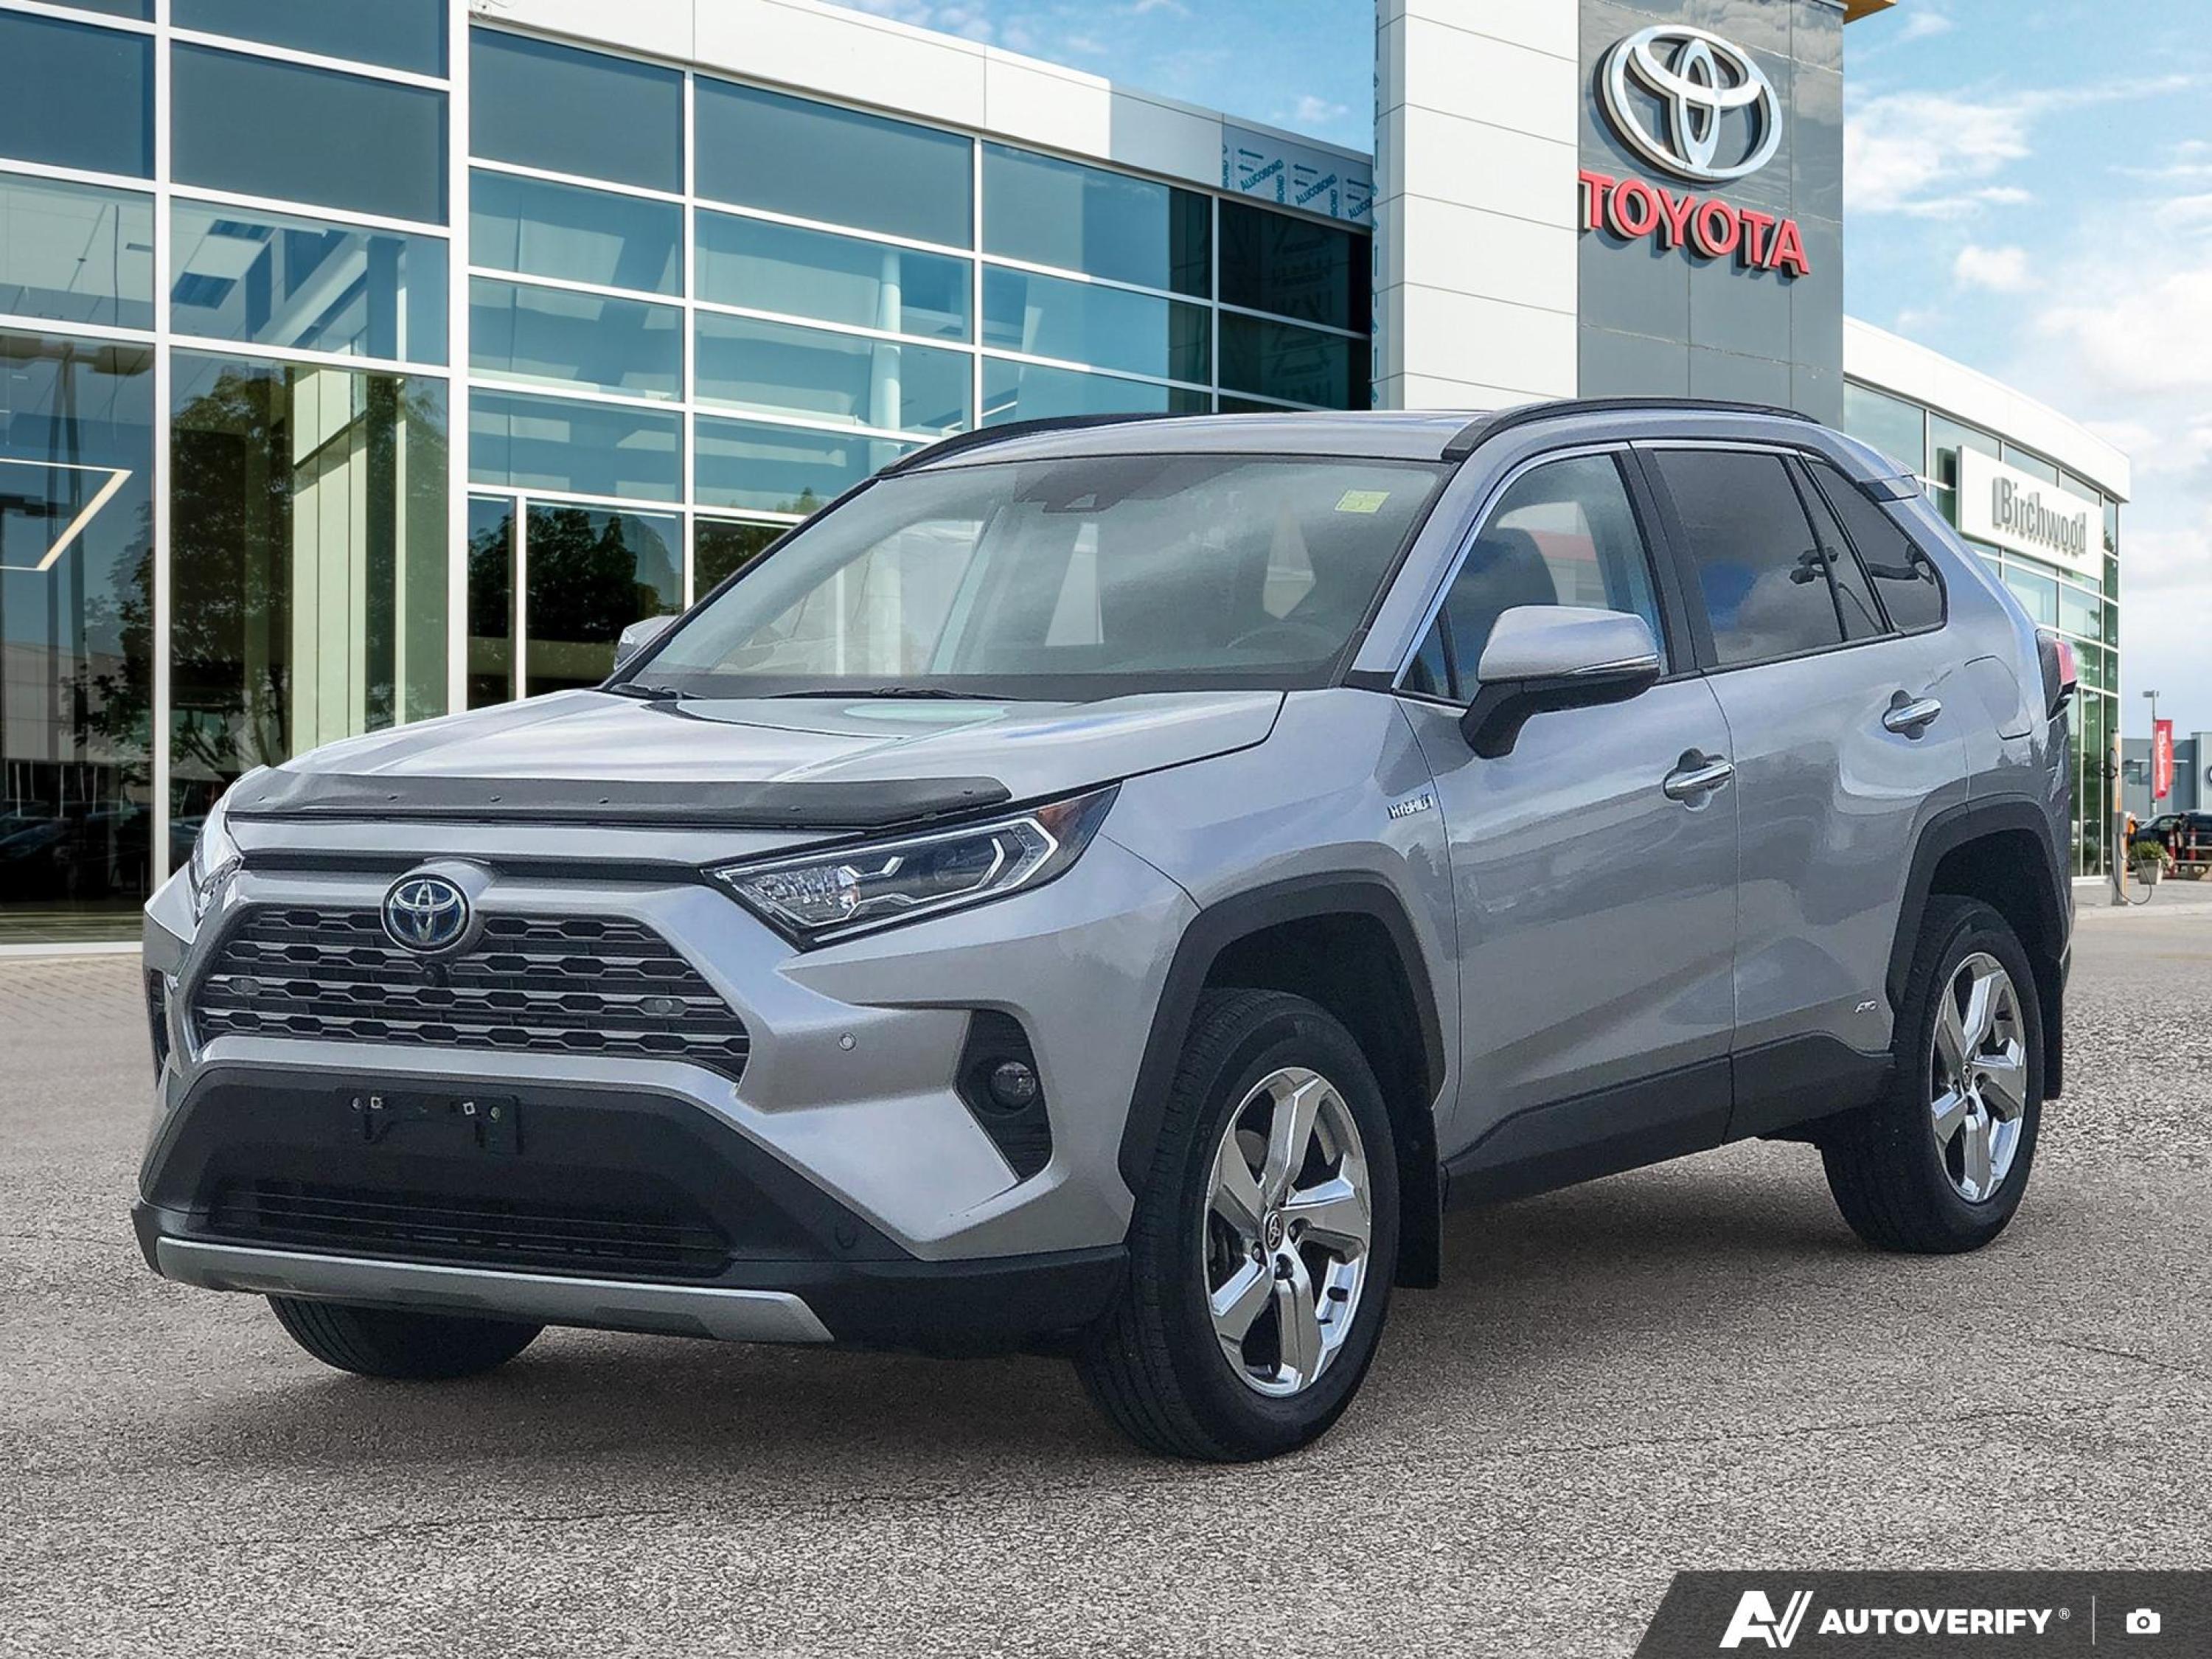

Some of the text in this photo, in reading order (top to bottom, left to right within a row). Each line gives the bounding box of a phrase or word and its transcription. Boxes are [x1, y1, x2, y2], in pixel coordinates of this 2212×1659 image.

[1240, 159, 1284, 192] ALUCOBOND
[1295, 173, 1337, 206] ALUCOBOND
[1348, 195, 1372, 219] ALUCO
[1579, 170, 1810, 275] TOYOTA
[1993, 478, 2086, 555] Birchwood
